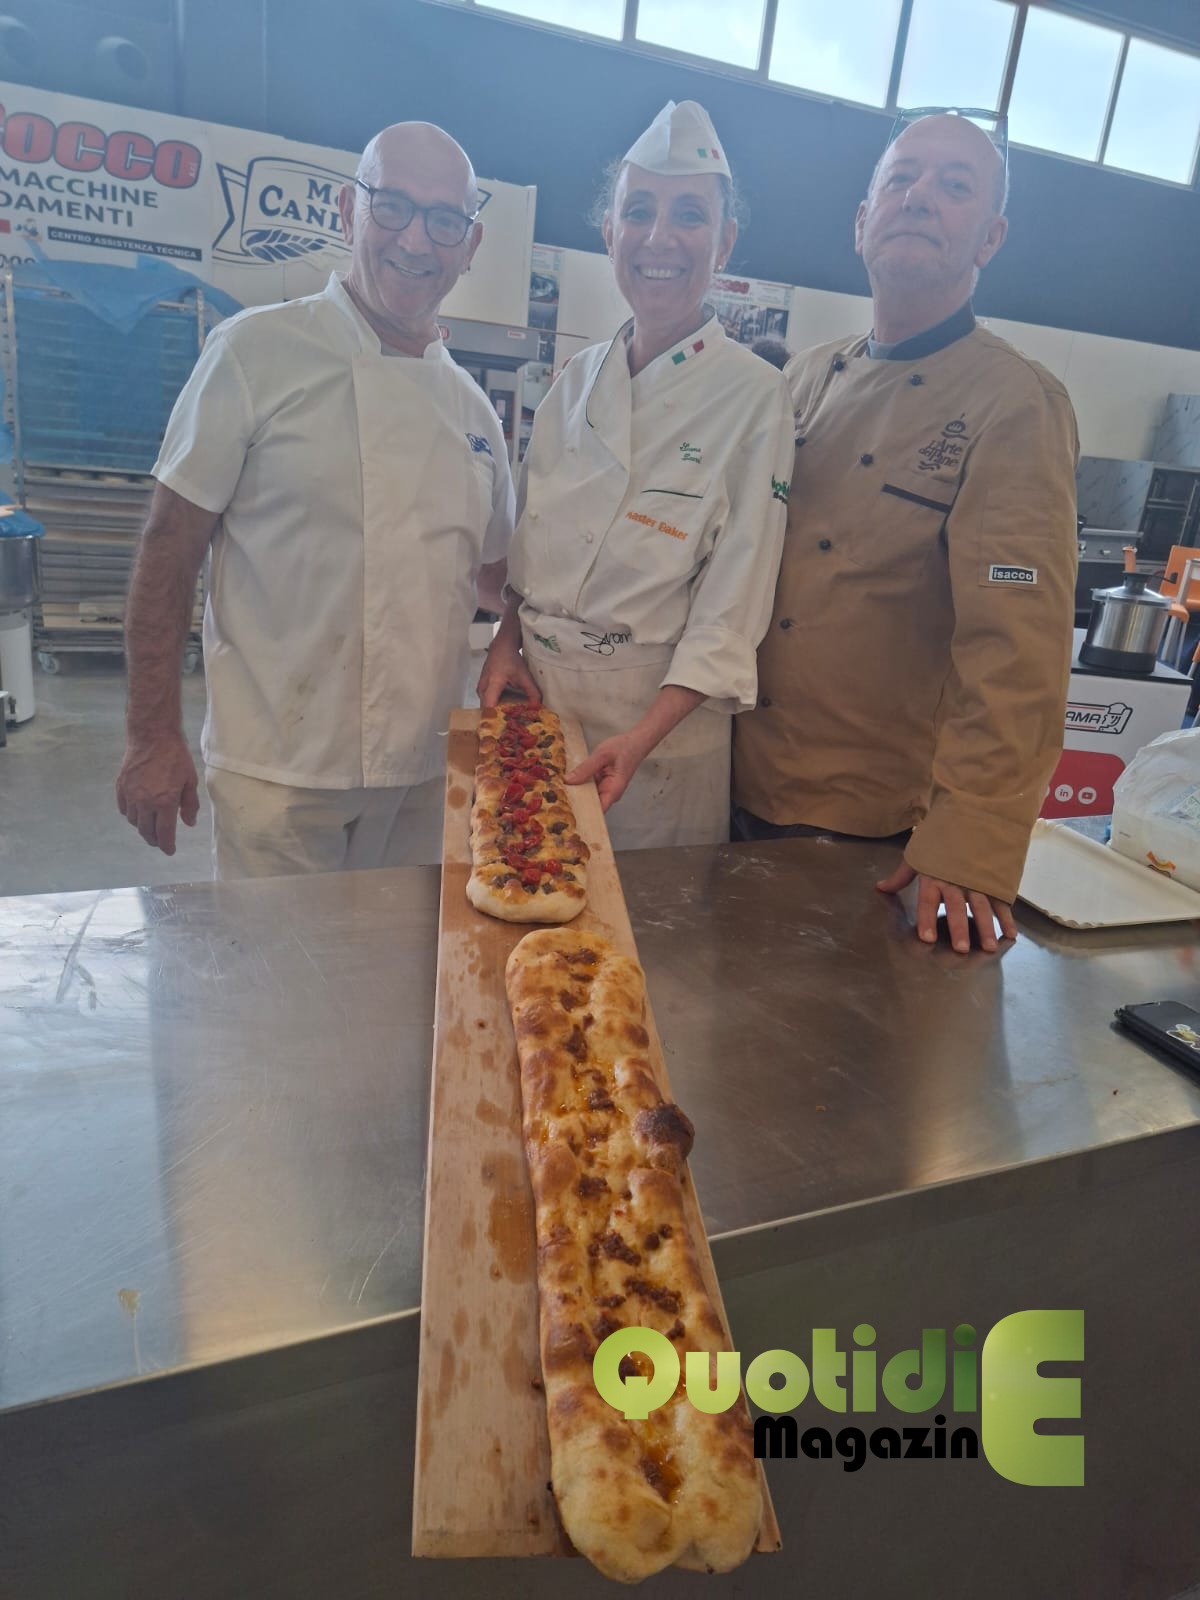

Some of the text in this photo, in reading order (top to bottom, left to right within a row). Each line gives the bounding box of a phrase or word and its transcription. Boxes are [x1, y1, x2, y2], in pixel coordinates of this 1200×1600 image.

[0, 103, 201, 189] OCCO
[0, 165, 158, 208] MACCHINE
[50, 230, 197, 259] CENTRO ASSISTENZA TECNICA
[658, 521, 688, 540] Baker
[993, 568, 1033, 581] isacco
